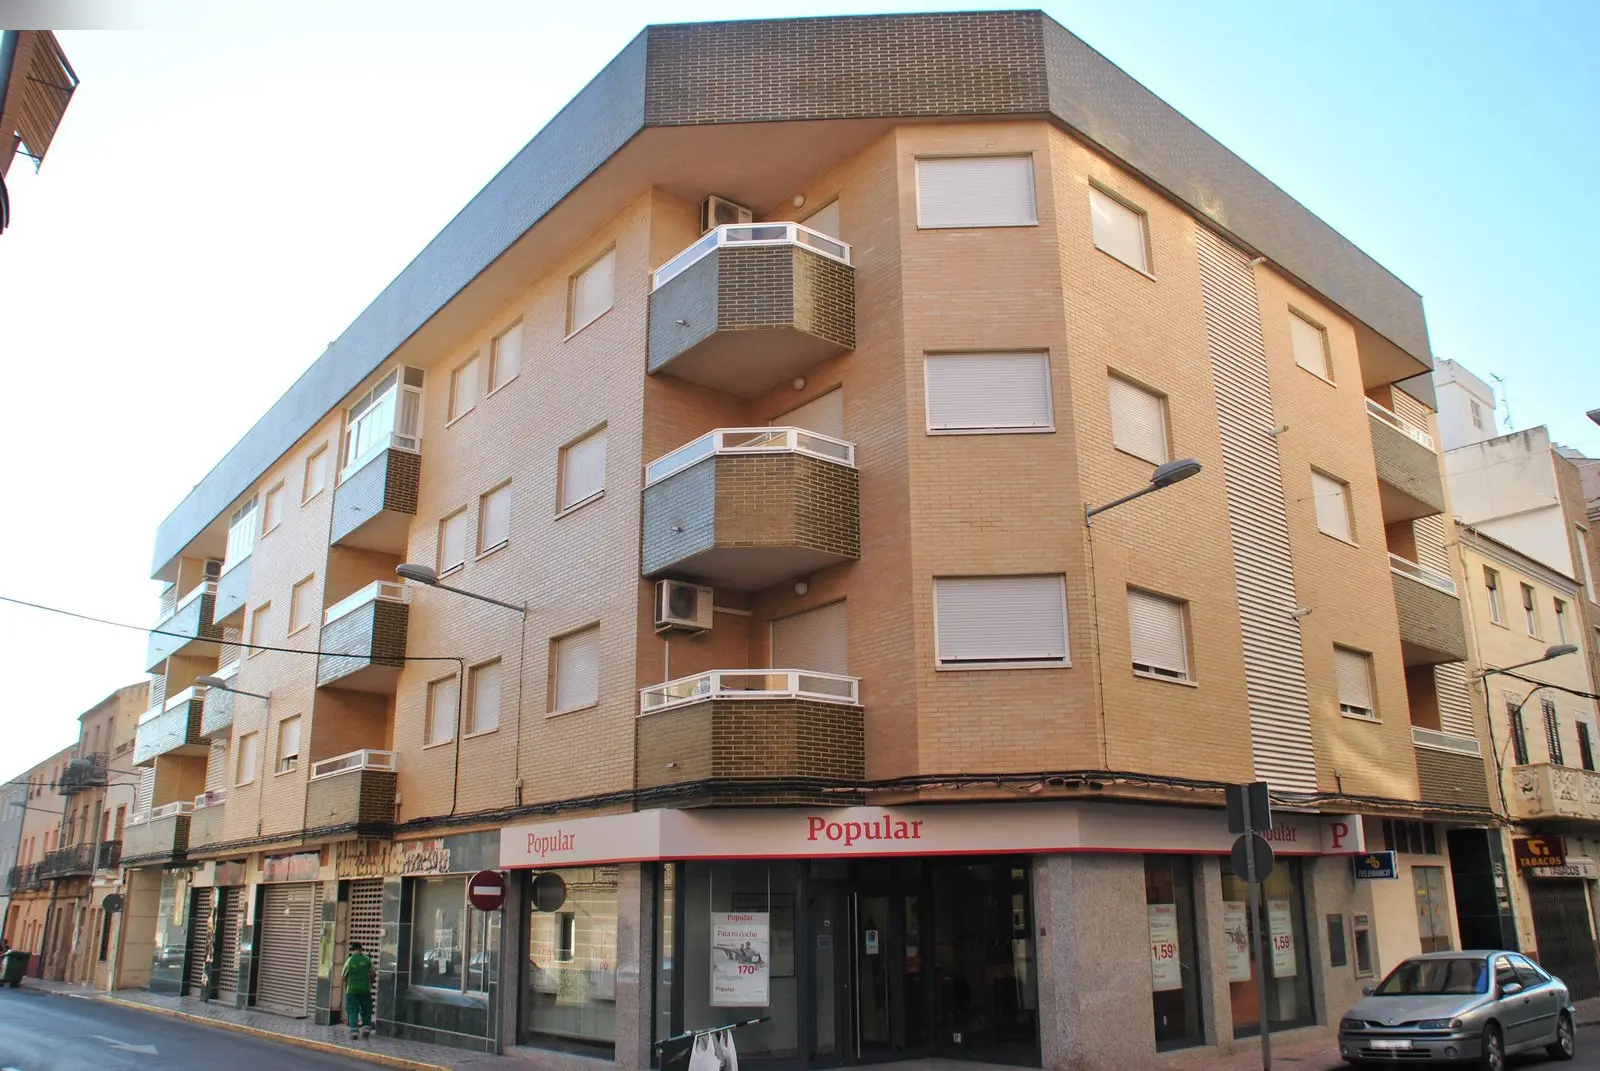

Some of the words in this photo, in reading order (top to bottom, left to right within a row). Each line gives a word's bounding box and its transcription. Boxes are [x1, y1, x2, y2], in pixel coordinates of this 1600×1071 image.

[527, 830, 575, 857] Popular
[807, 815, 923, 846] Popular
[1330, 822, 1349, 849] P
[1520, 857, 1561, 866] TABACOS
[727, 913, 753, 921] Popular
